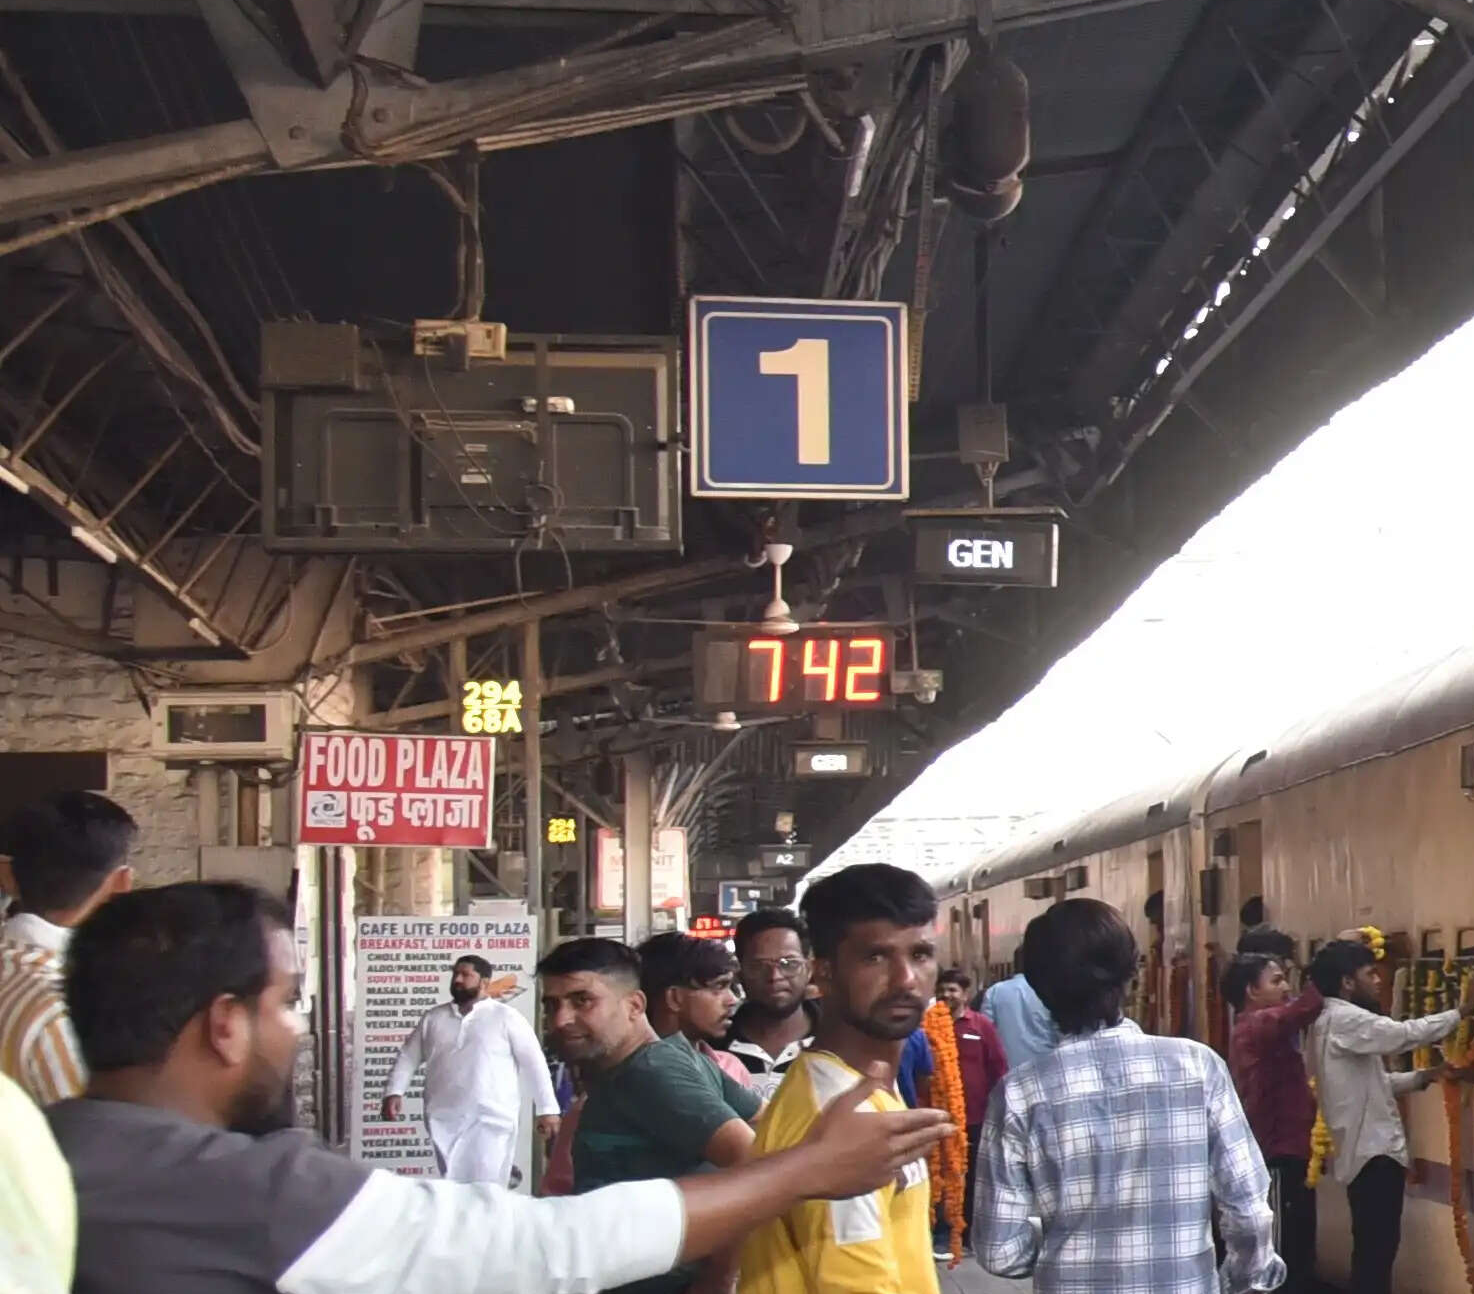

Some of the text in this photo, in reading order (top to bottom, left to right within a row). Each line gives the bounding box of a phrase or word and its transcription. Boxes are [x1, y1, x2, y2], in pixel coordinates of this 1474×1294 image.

[758, 338, 830, 465] 1
[948, 538, 1014, 570] GEN
[462, 680, 523, 705] 294
[462, 707, 523, 734] 68A
[309, 736, 485, 789] FOOD PLAZA
[350, 791, 484, 841] फूड प्लाजा
[360, 922, 531, 935] CAFE LITE FOOD PLAZA
[432, 938, 471, 949] LUNCH
[488, 938, 530, 949] DINNER
[367, 976, 401, 984] SOUTH
[366, 987, 440, 995] MASALA DOSA
[366, 998, 406, 1006] PANEER
[362, 1139, 420, 1148] VEGETABLE
